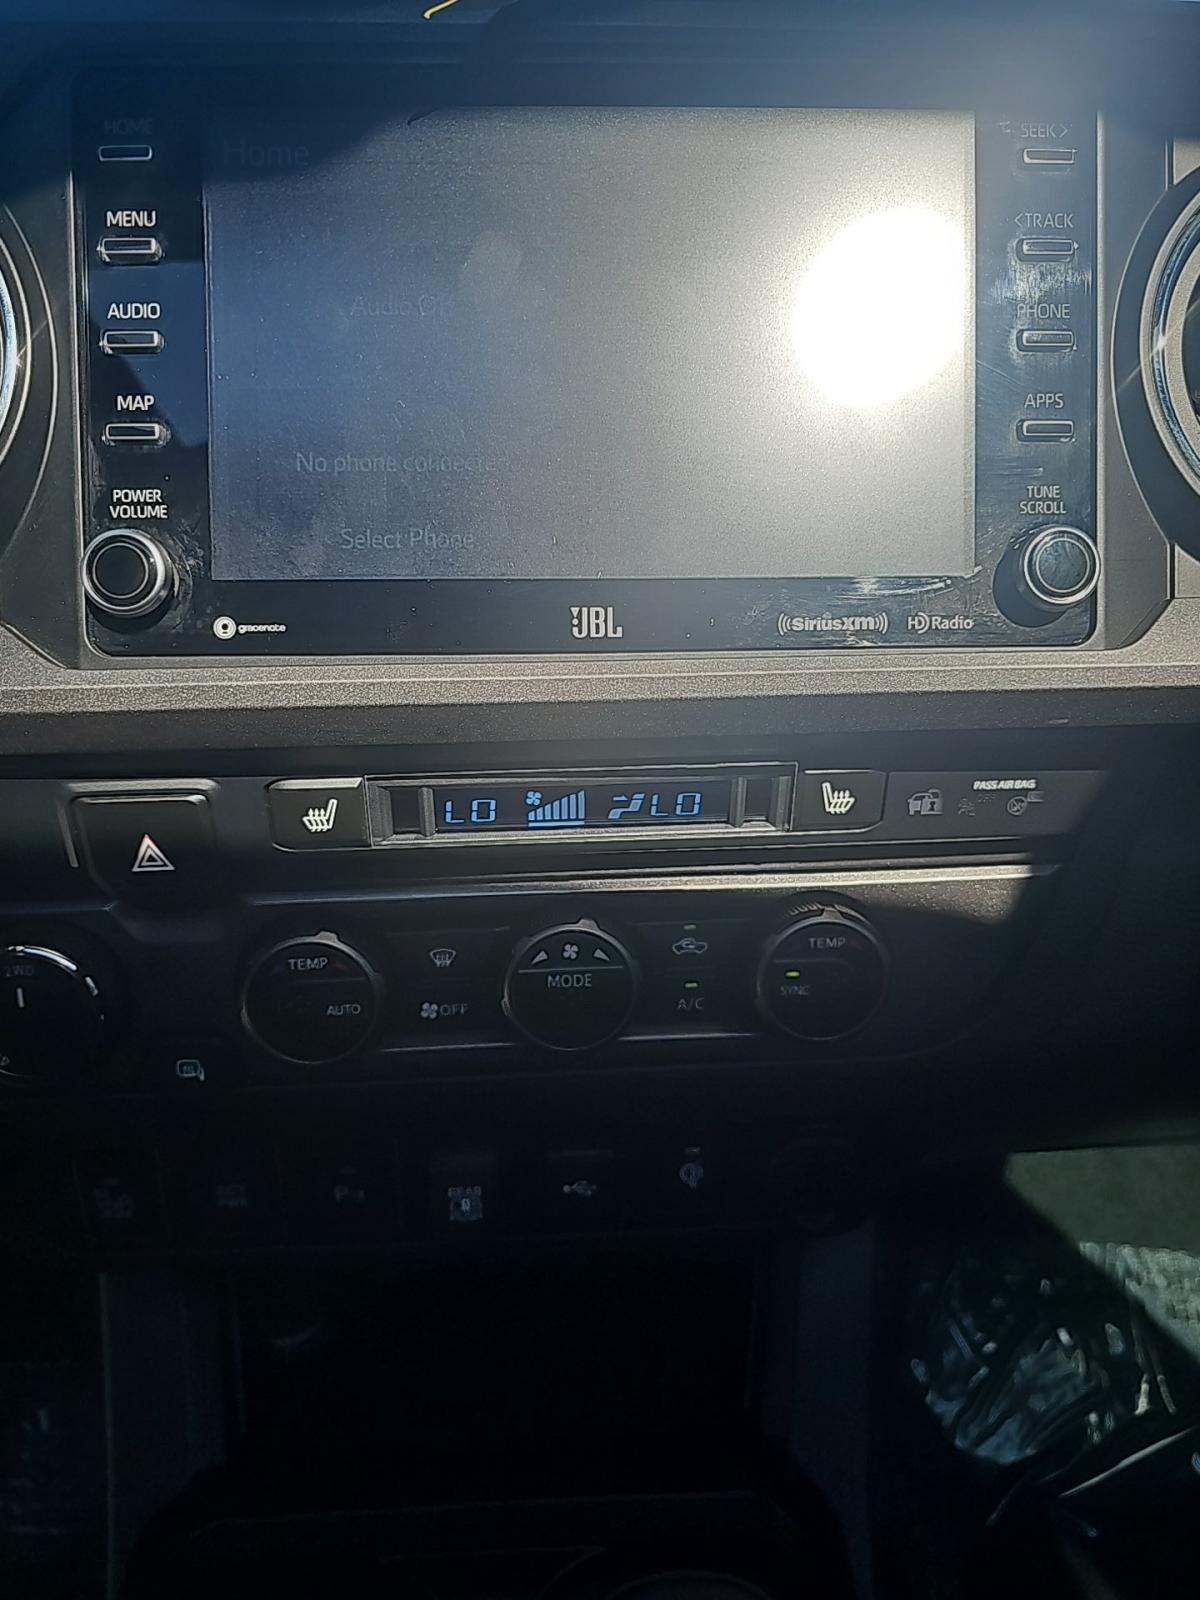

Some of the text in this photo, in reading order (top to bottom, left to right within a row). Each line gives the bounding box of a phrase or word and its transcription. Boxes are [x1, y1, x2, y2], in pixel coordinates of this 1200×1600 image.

[224, 139, 309, 166] Home
[106, 210, 157, 227] MENU
[107, 303, 161, 319] AUDIO
[1017, 303, 1071, 319] PHONE
[116, 395, 155, 411] MAP
[1024, 393, 1064, 409] APPS
[296, 451, 327, 473] No
[334, 451, 397, 477] phone
[113, 489, 162, 503] POWER
[1027, 485, 1060, 499] TUNE
[109, 504, 168, 519] VOLUME
[1020, 501, 1067, 514] SCROLL
[340, 526, 475, 550] Select Phone
[570, 606, 624, 639] JBL
[931, 614, 974, 631] Radio
[445, 799, 497, 823] LO
[650, 793, 702, 817] LO
[808, 937, 846, 949] TEMP
[288, 957, 328, 971] TEMP
[547, 973, 593, 989] MODE
[326, 1004, 361, 1016] AUTO
[440, 1004, 469, 1016] OFF
[677, 998, 705, 1011] A/C
